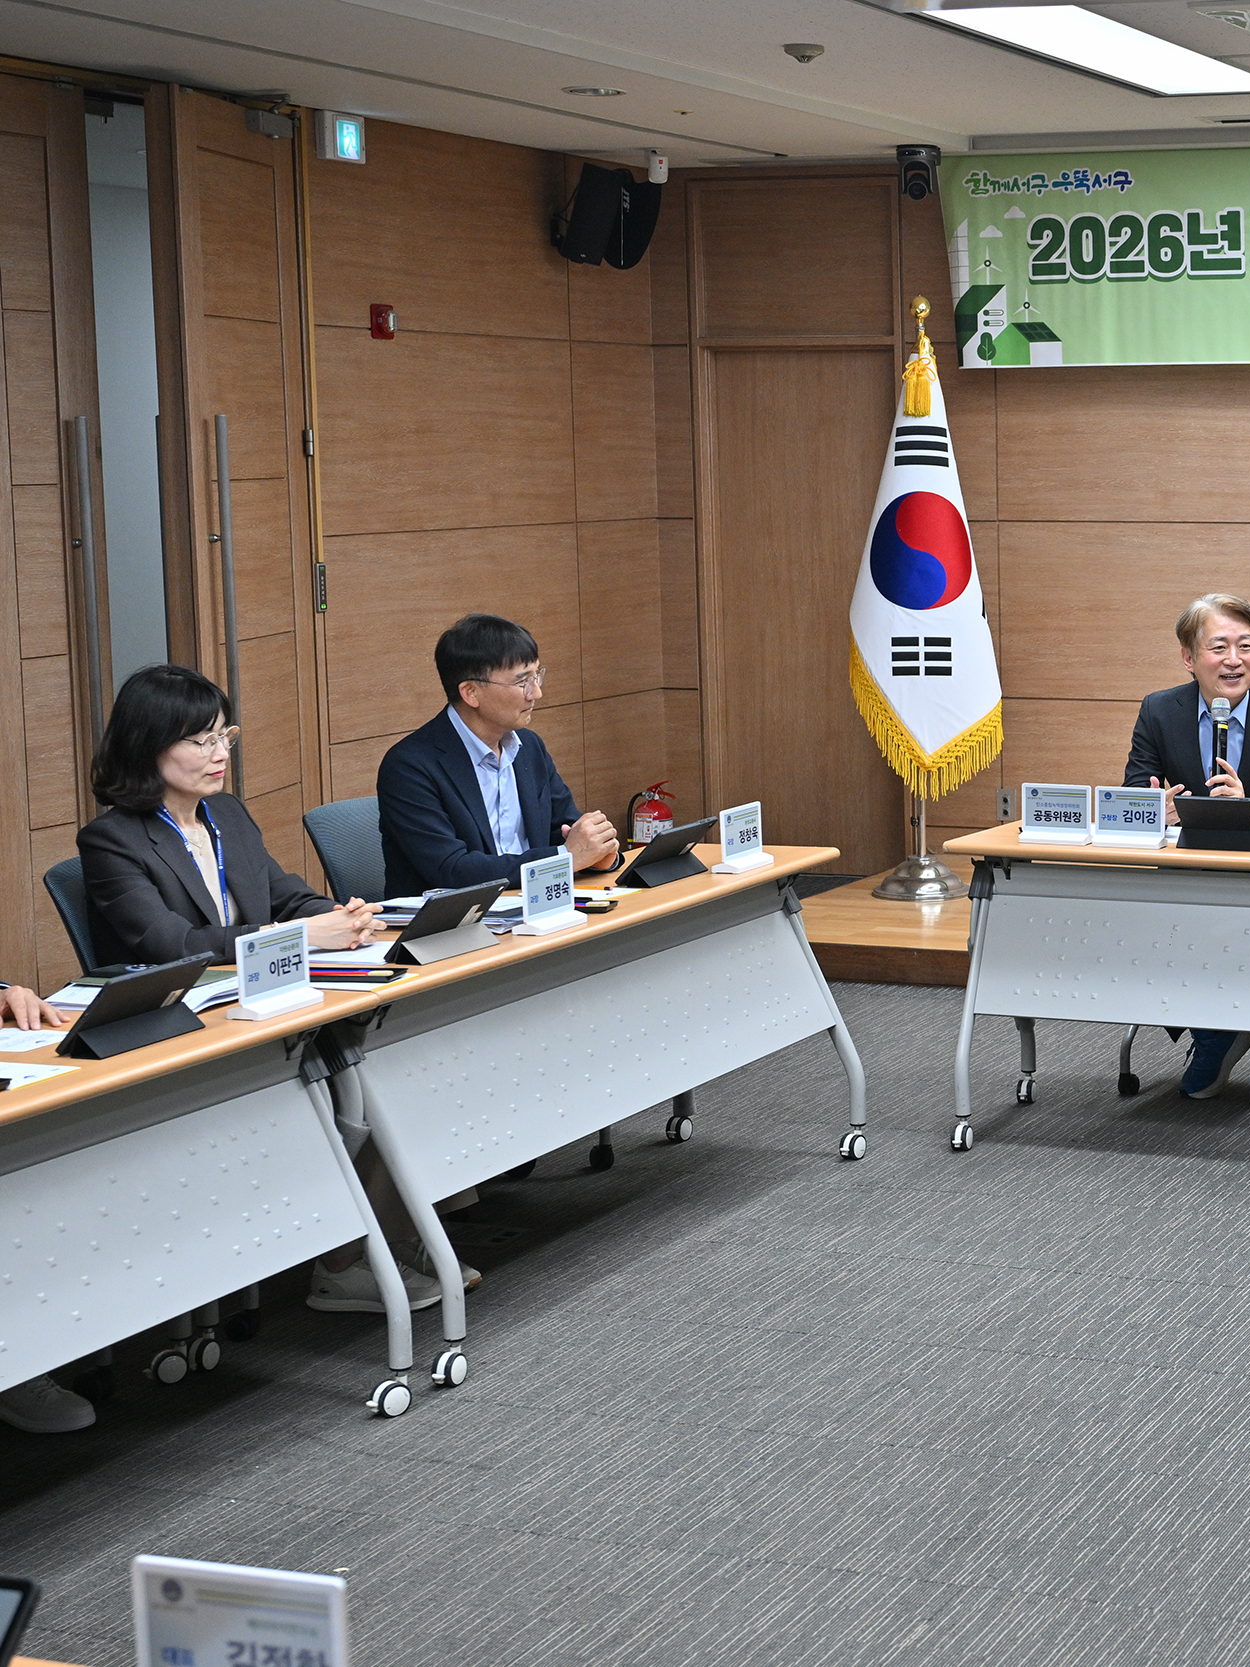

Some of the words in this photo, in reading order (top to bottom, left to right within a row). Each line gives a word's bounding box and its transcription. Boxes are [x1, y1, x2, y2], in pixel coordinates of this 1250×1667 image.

[964, 171, 1050, 197] 함께서구
[1051, 168, 1134, 195] 우뚝서구
[1027, 207, 1245, 282] 2026년
[1033, 809, 1083, 824] 공동위원장
[1100, 813, 1118, 822] 구청장
[1122, 809, 1158, 825] 김이강
[738, 826, 759, 844] 정창욱
[545, 880, 570, 902] 정명숙
[247, 971, 260, 983] 과장
[268, 953, 303, 977] 이판구
